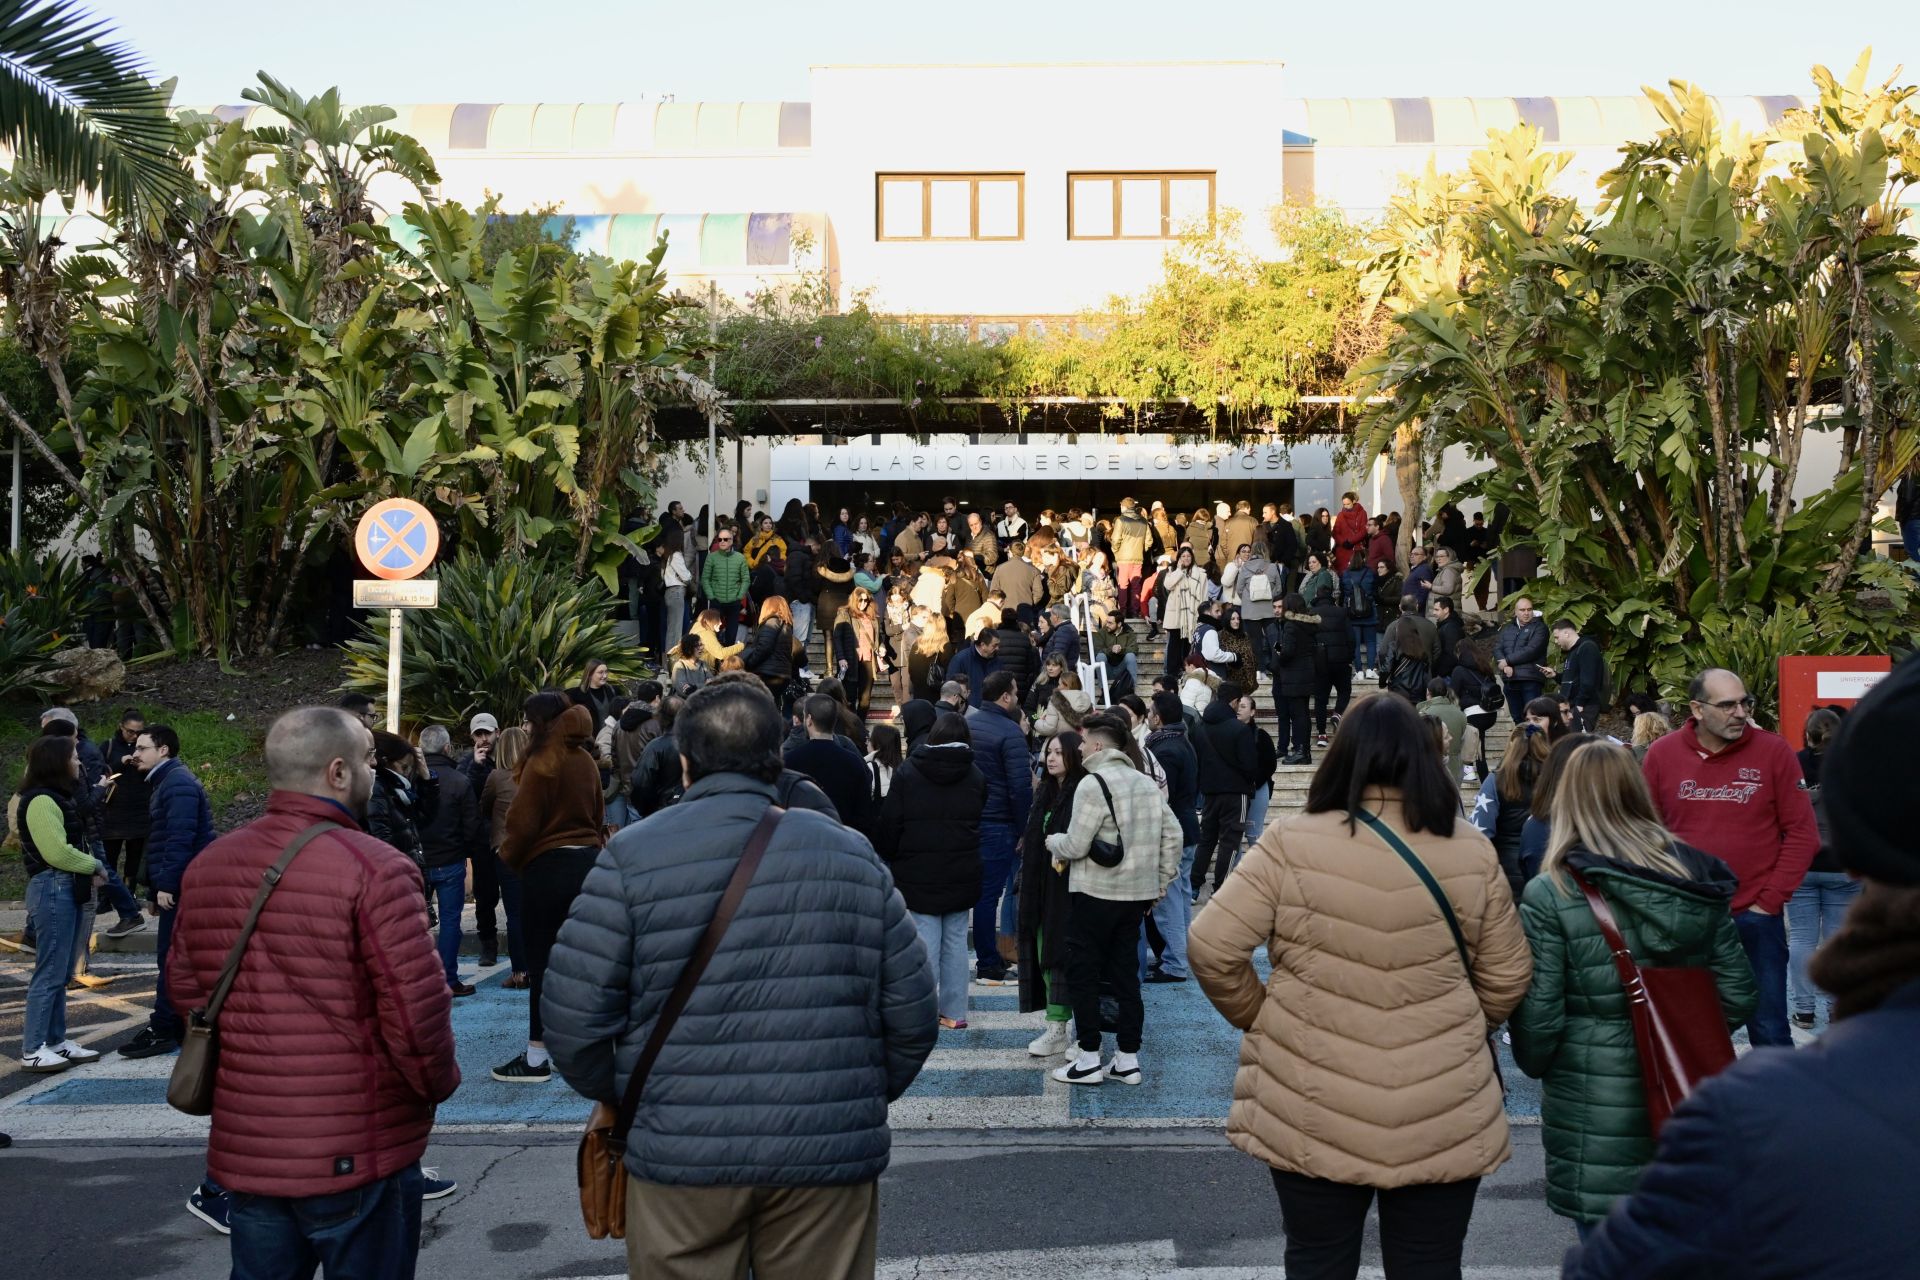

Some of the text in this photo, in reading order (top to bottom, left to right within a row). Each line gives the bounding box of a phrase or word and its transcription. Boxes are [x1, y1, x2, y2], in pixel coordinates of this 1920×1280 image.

[825, 455, 962, 471] AULARIO
[978, 455, 1070, 471] GINER
[1084, 455, 1120, 471] DE
[1135, 455, 1193, 471] LOS
[1738, 767, 1761, 781] SC
[1679, 779, 1758, 804] Bendorff
